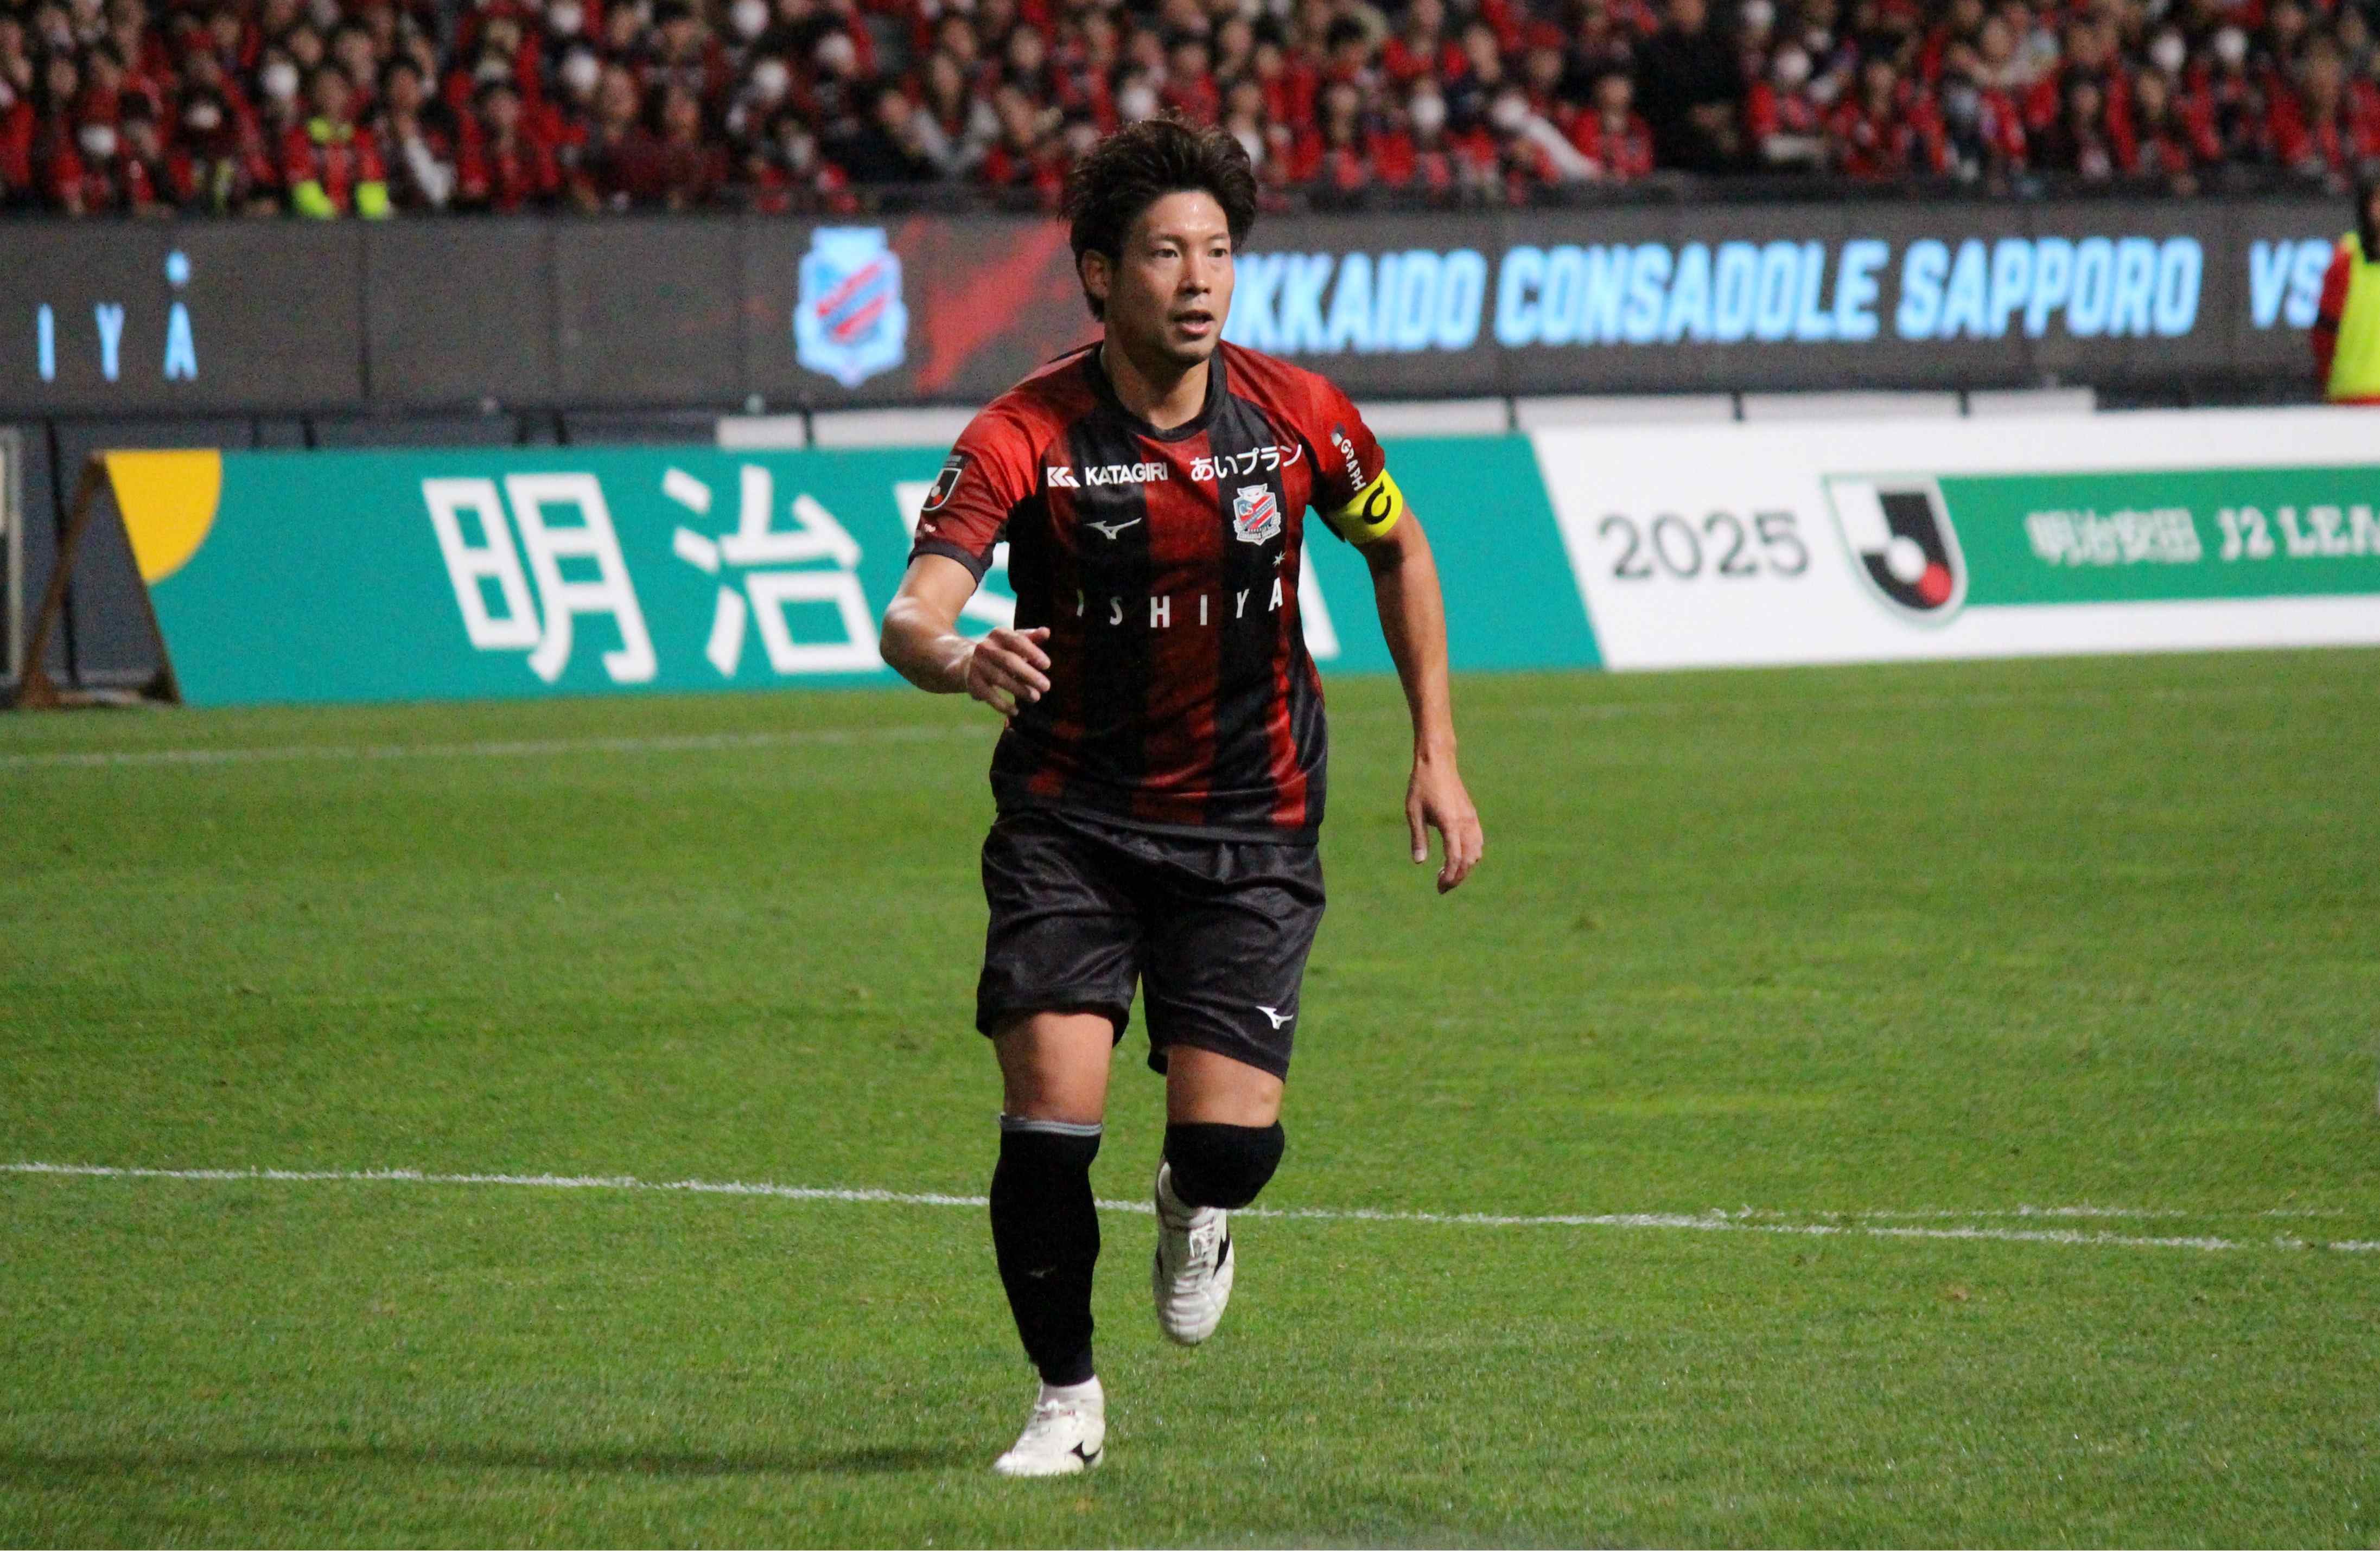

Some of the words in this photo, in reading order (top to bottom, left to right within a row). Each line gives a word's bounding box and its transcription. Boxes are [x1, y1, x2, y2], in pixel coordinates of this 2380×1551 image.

[1220, 250, 1486, 353] KKAIDO
[1494, 241, 1890, 344] CONSADOLE
[1894, 236, 2204, 340] SAPPORO
[1085, 461, 1169, 486] KATAGIRI
[1190, 444, 1303, 483] あいプラン
[1340, 438, 1366, 491] GRAPH
[1362, 480, 1392, 525] C
[1598, 510, 1810, 579] 2025
[2216, 505, 2275, 562] J2
